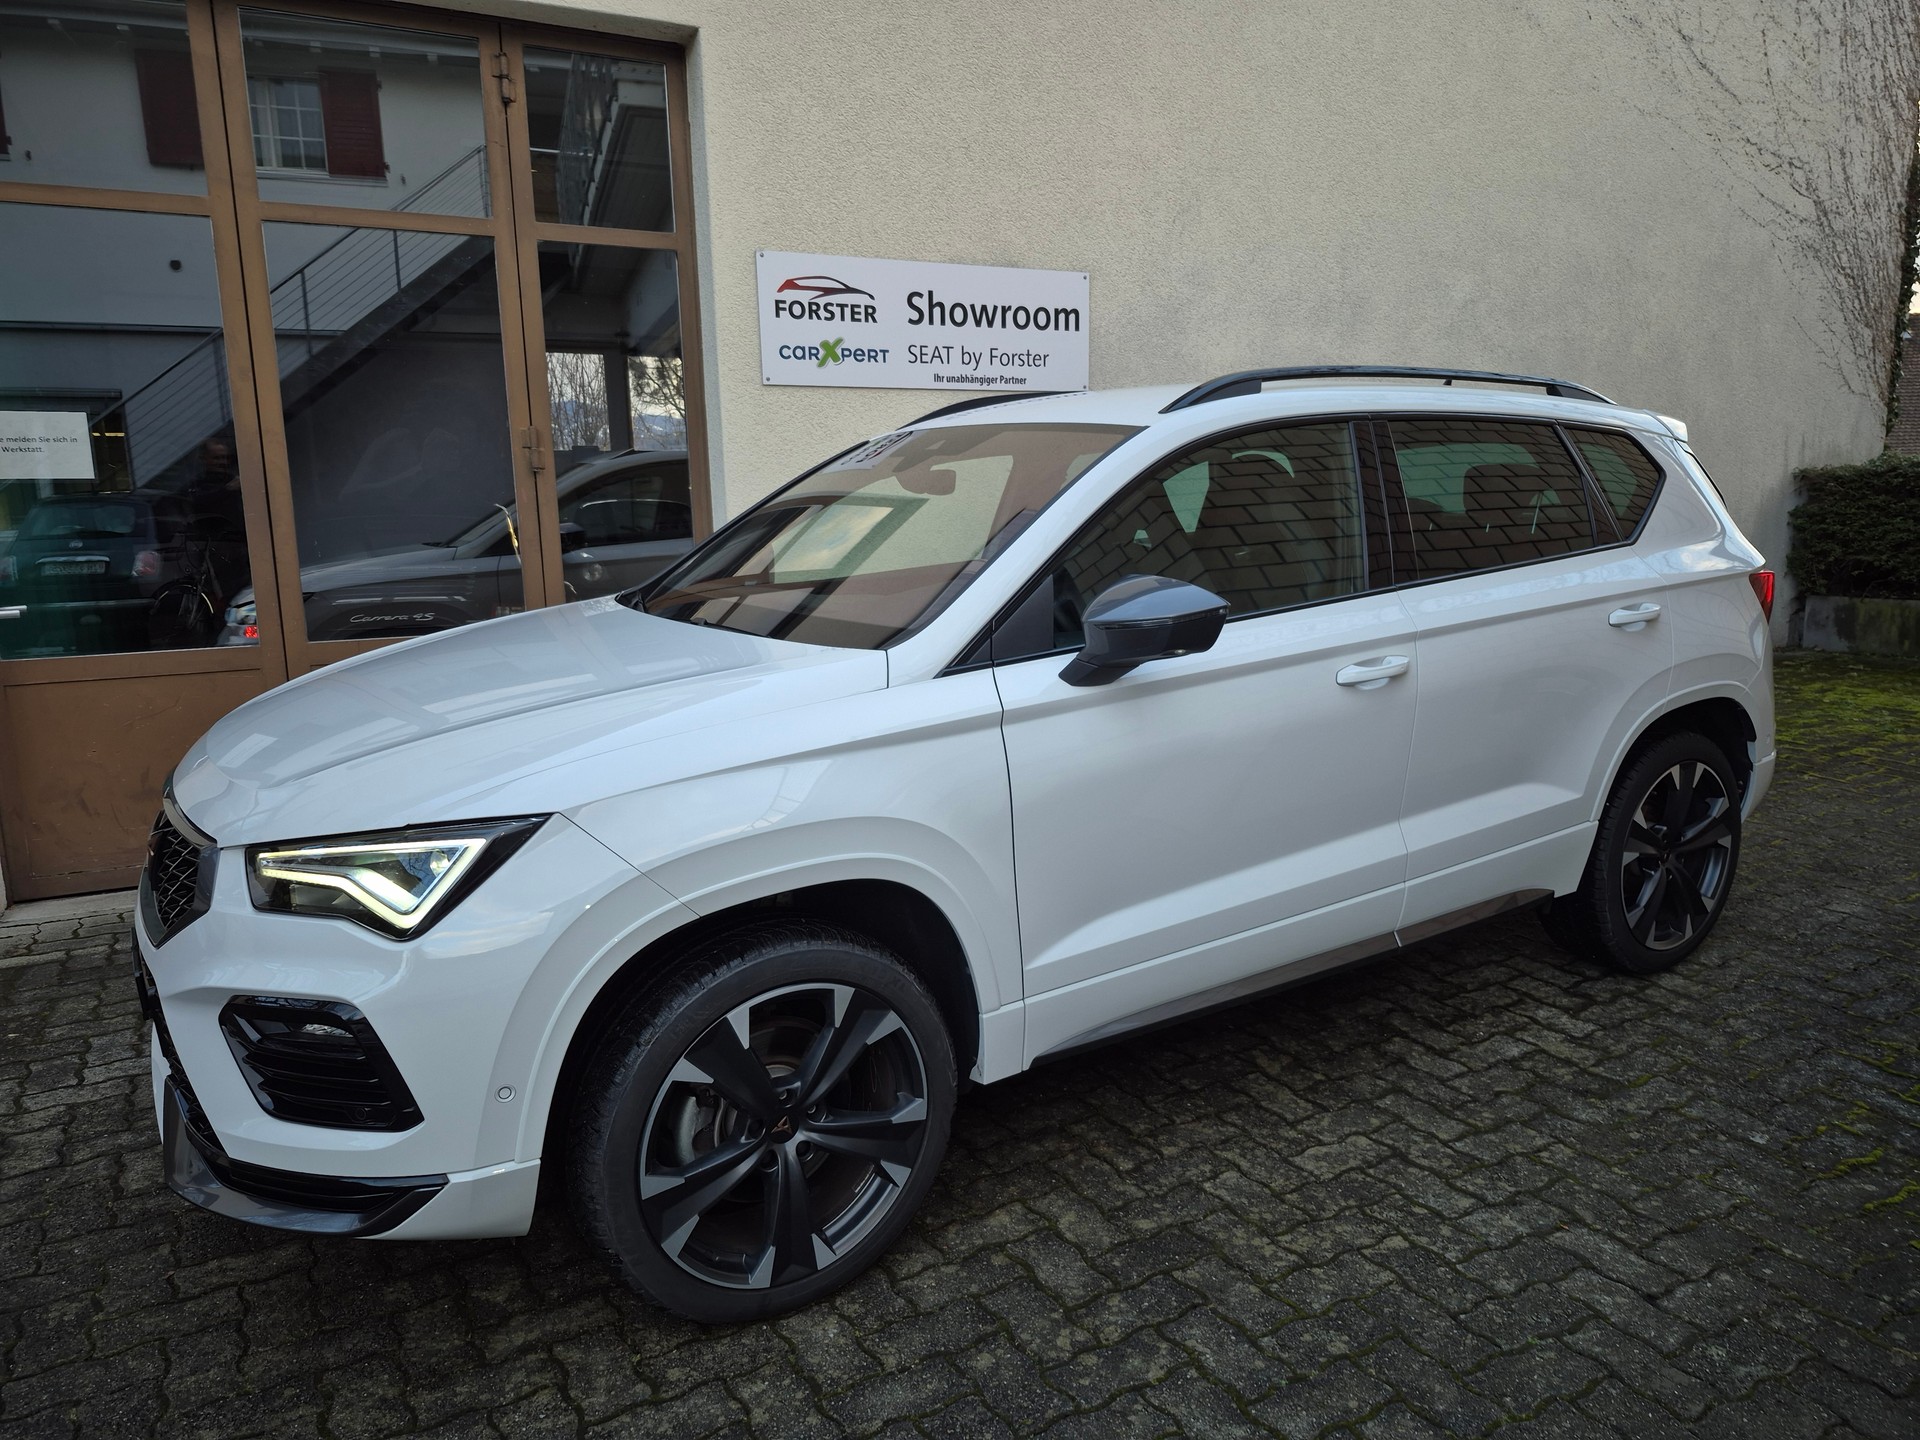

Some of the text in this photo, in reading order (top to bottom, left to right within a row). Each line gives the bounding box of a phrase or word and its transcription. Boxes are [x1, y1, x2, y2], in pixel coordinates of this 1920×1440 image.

[774, 299, 878, 324] FORSTER
[906, 290, 1080, 332] Showroom
[908, 344, 1050, 371] SEAT by Forster
[933, 373, 1027, 386] Ihr unabhängiger Partner
[349, 614, 409, 623] Carrera
